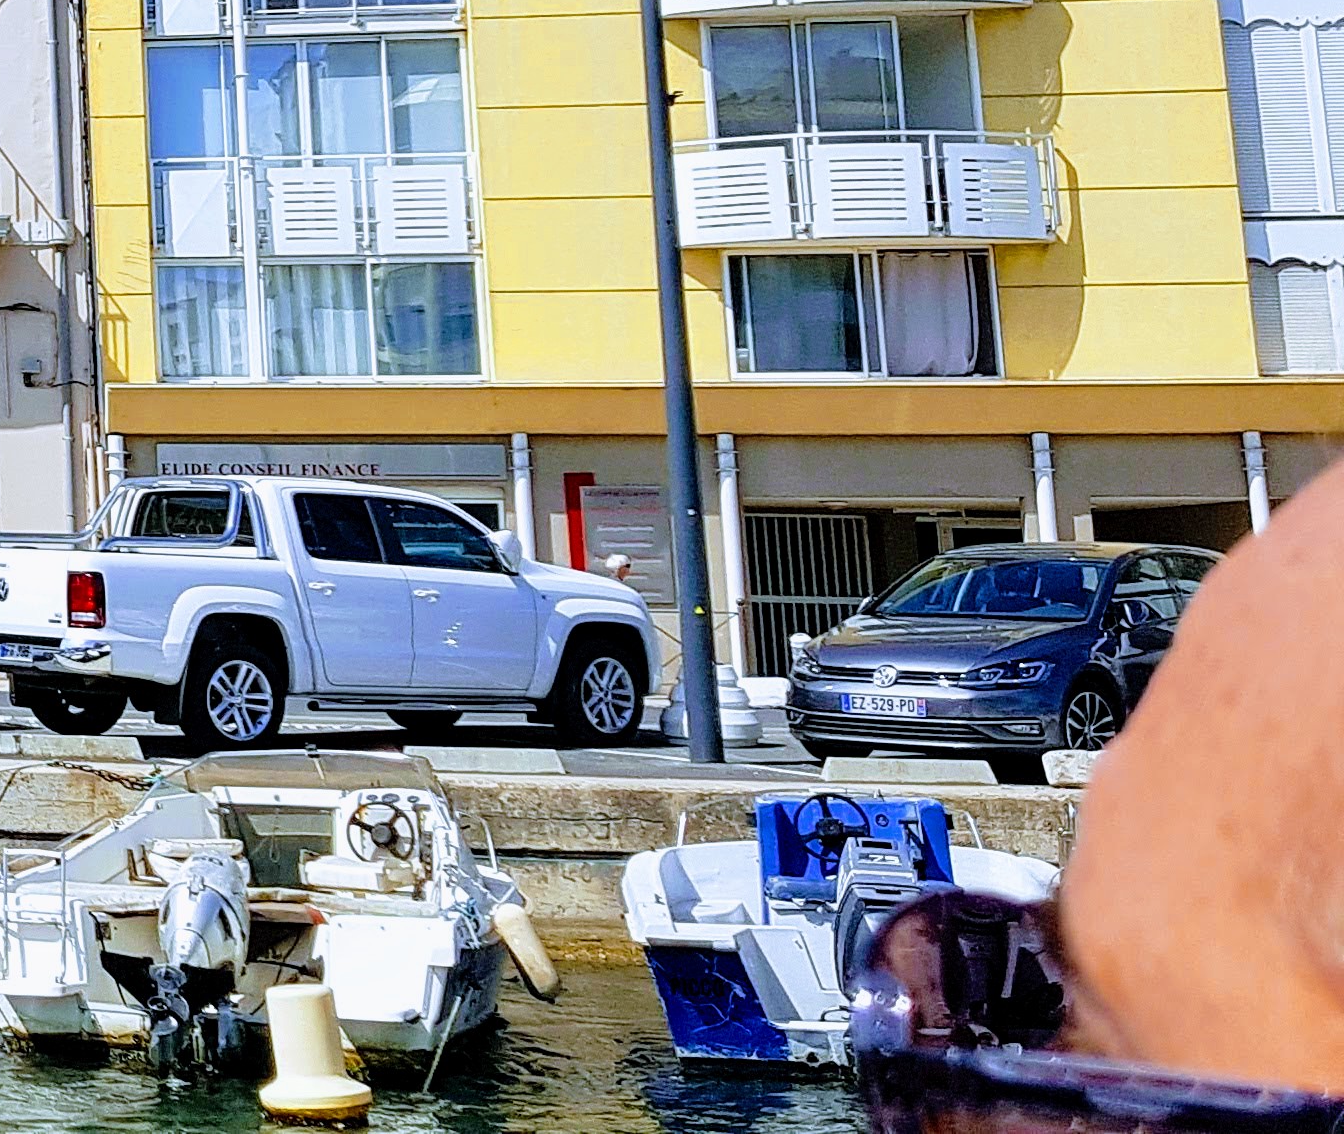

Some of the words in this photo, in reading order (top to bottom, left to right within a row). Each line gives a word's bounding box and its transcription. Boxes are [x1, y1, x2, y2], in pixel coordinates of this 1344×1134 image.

[162, 463, 214, 476] ELIDE
[219, 463, 296, 476] CONSEIL
[301, 463, 381, 477] FINANCE
